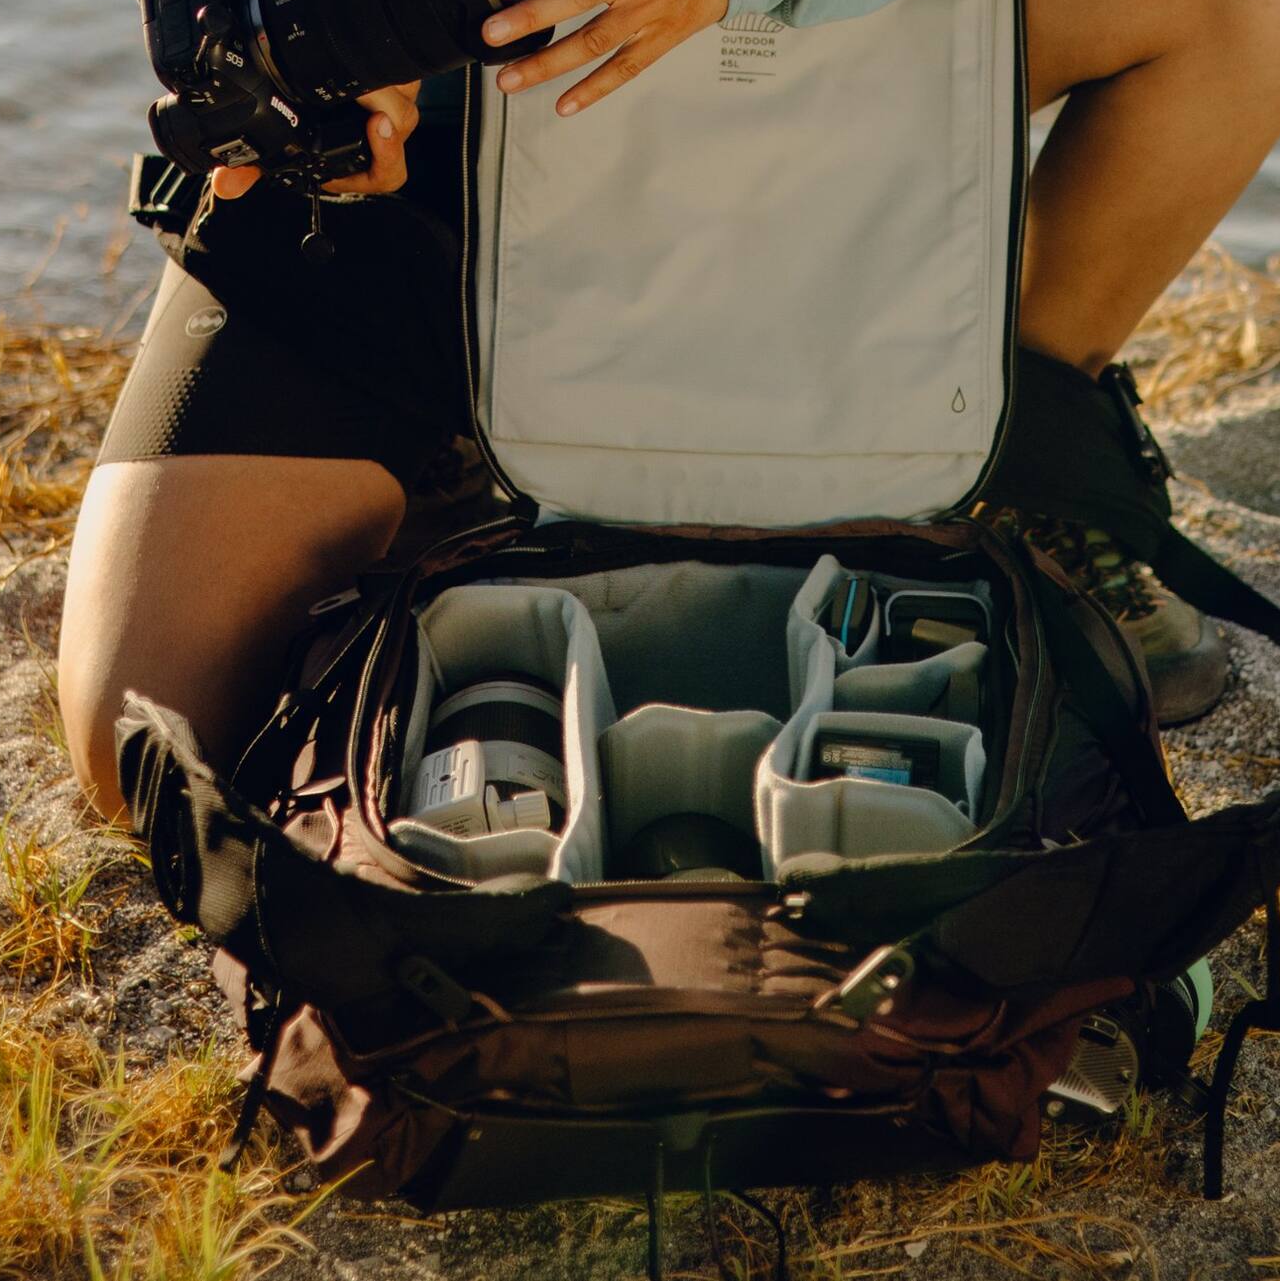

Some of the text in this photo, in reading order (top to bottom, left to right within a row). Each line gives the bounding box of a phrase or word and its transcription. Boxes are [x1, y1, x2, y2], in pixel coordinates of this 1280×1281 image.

[720, 35, 776, 46] OUTDOOR
[225, 51, 244, 68] EOS
[720, 47, 777, 58] BACKPACK
[270, 95, 299, 128] Canon
